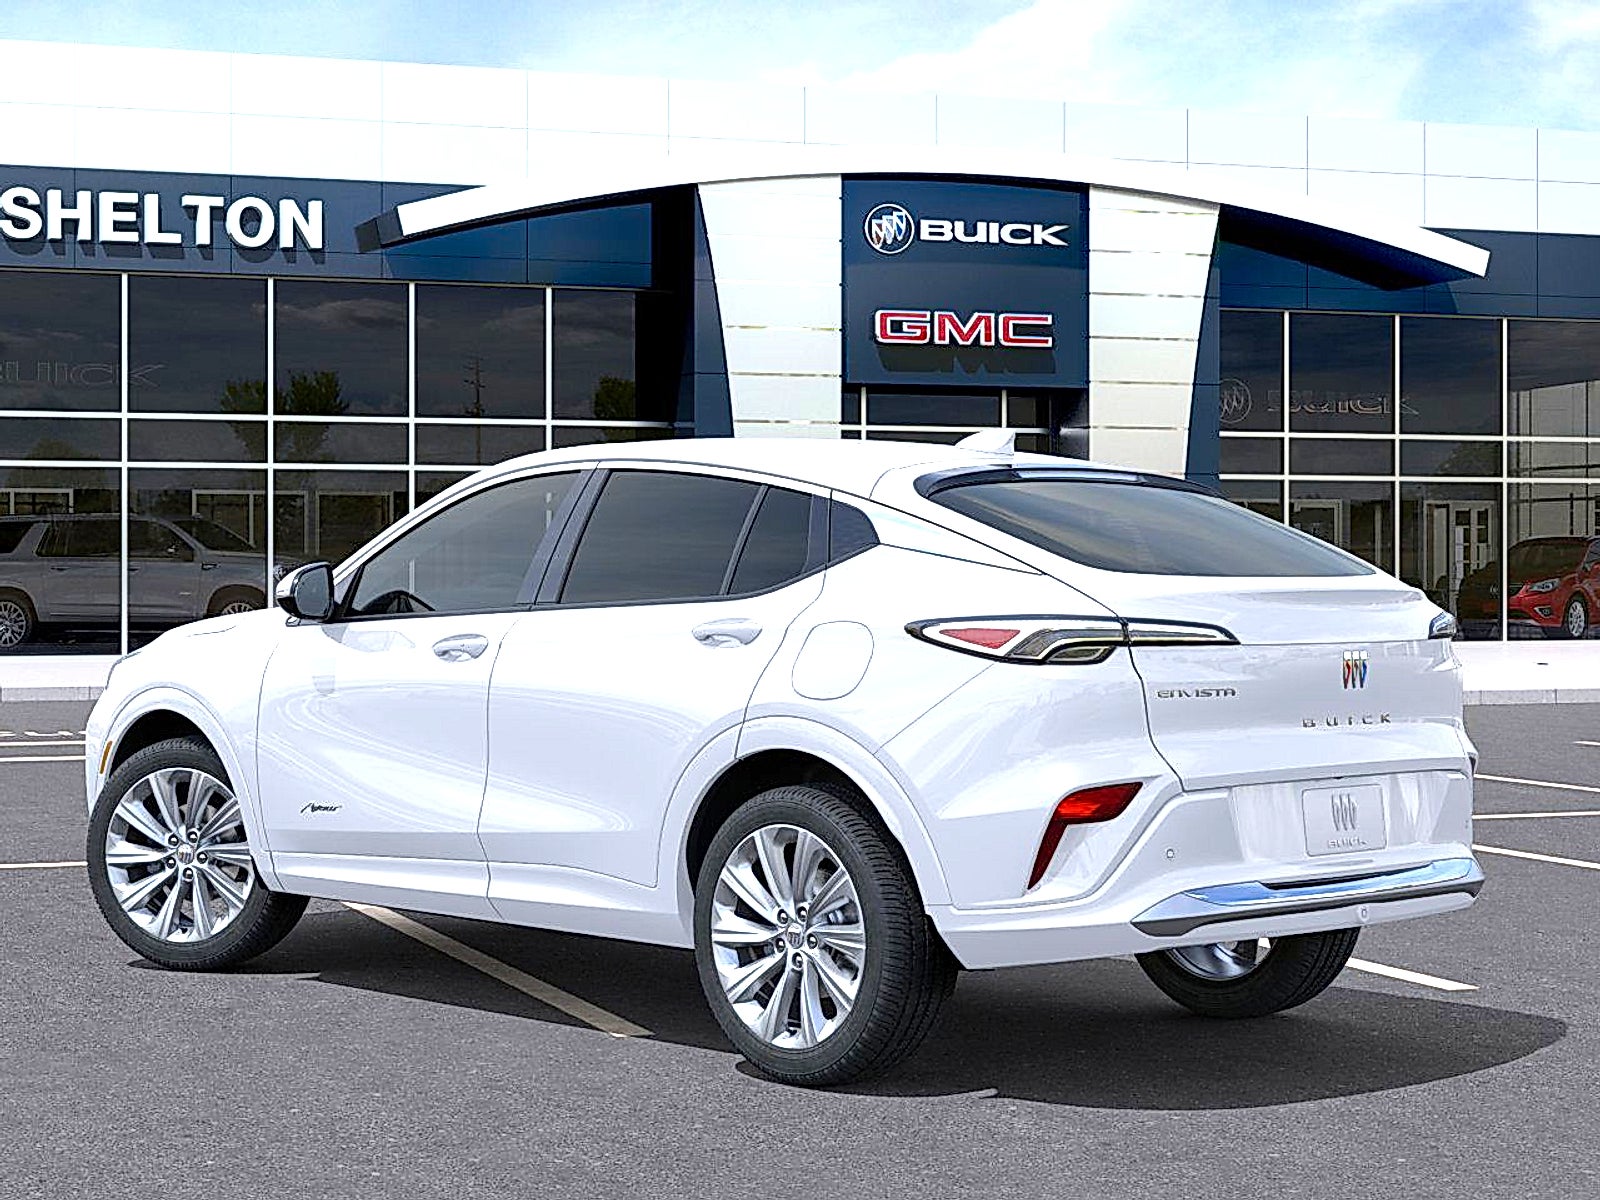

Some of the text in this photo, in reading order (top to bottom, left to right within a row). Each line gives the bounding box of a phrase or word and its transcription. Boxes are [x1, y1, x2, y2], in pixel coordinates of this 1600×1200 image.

[0, 187, 323, 250] SHELTON
[920, 219, 1069, 246] BUICK
[875, 309, 1053, 347] GMC
[1302, 713, 1391, 728] BUICK
